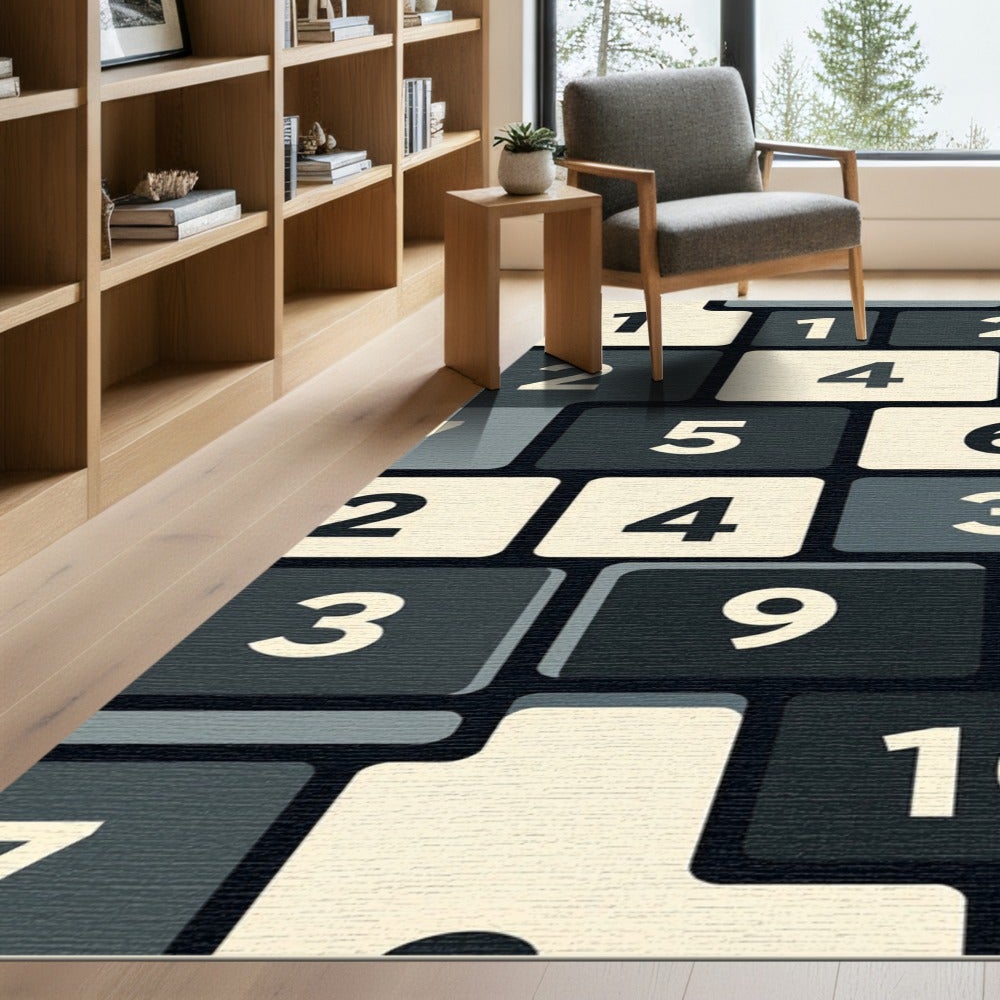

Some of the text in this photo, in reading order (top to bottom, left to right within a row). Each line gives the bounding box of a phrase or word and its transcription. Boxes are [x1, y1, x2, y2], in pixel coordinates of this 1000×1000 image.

[613, 312, 647, 333] 1
[797, 318, 835, 338] 1
[517, 363, 613, 390] 2
[817, 362, 904, 388] 4
[649, 421, 747, 454] 5
[307, 493, 428, 538] 2
[622, 497, 738, 541] 4
[248, 591, 405, 658] 3
[722, 587, 837, 649] 9
